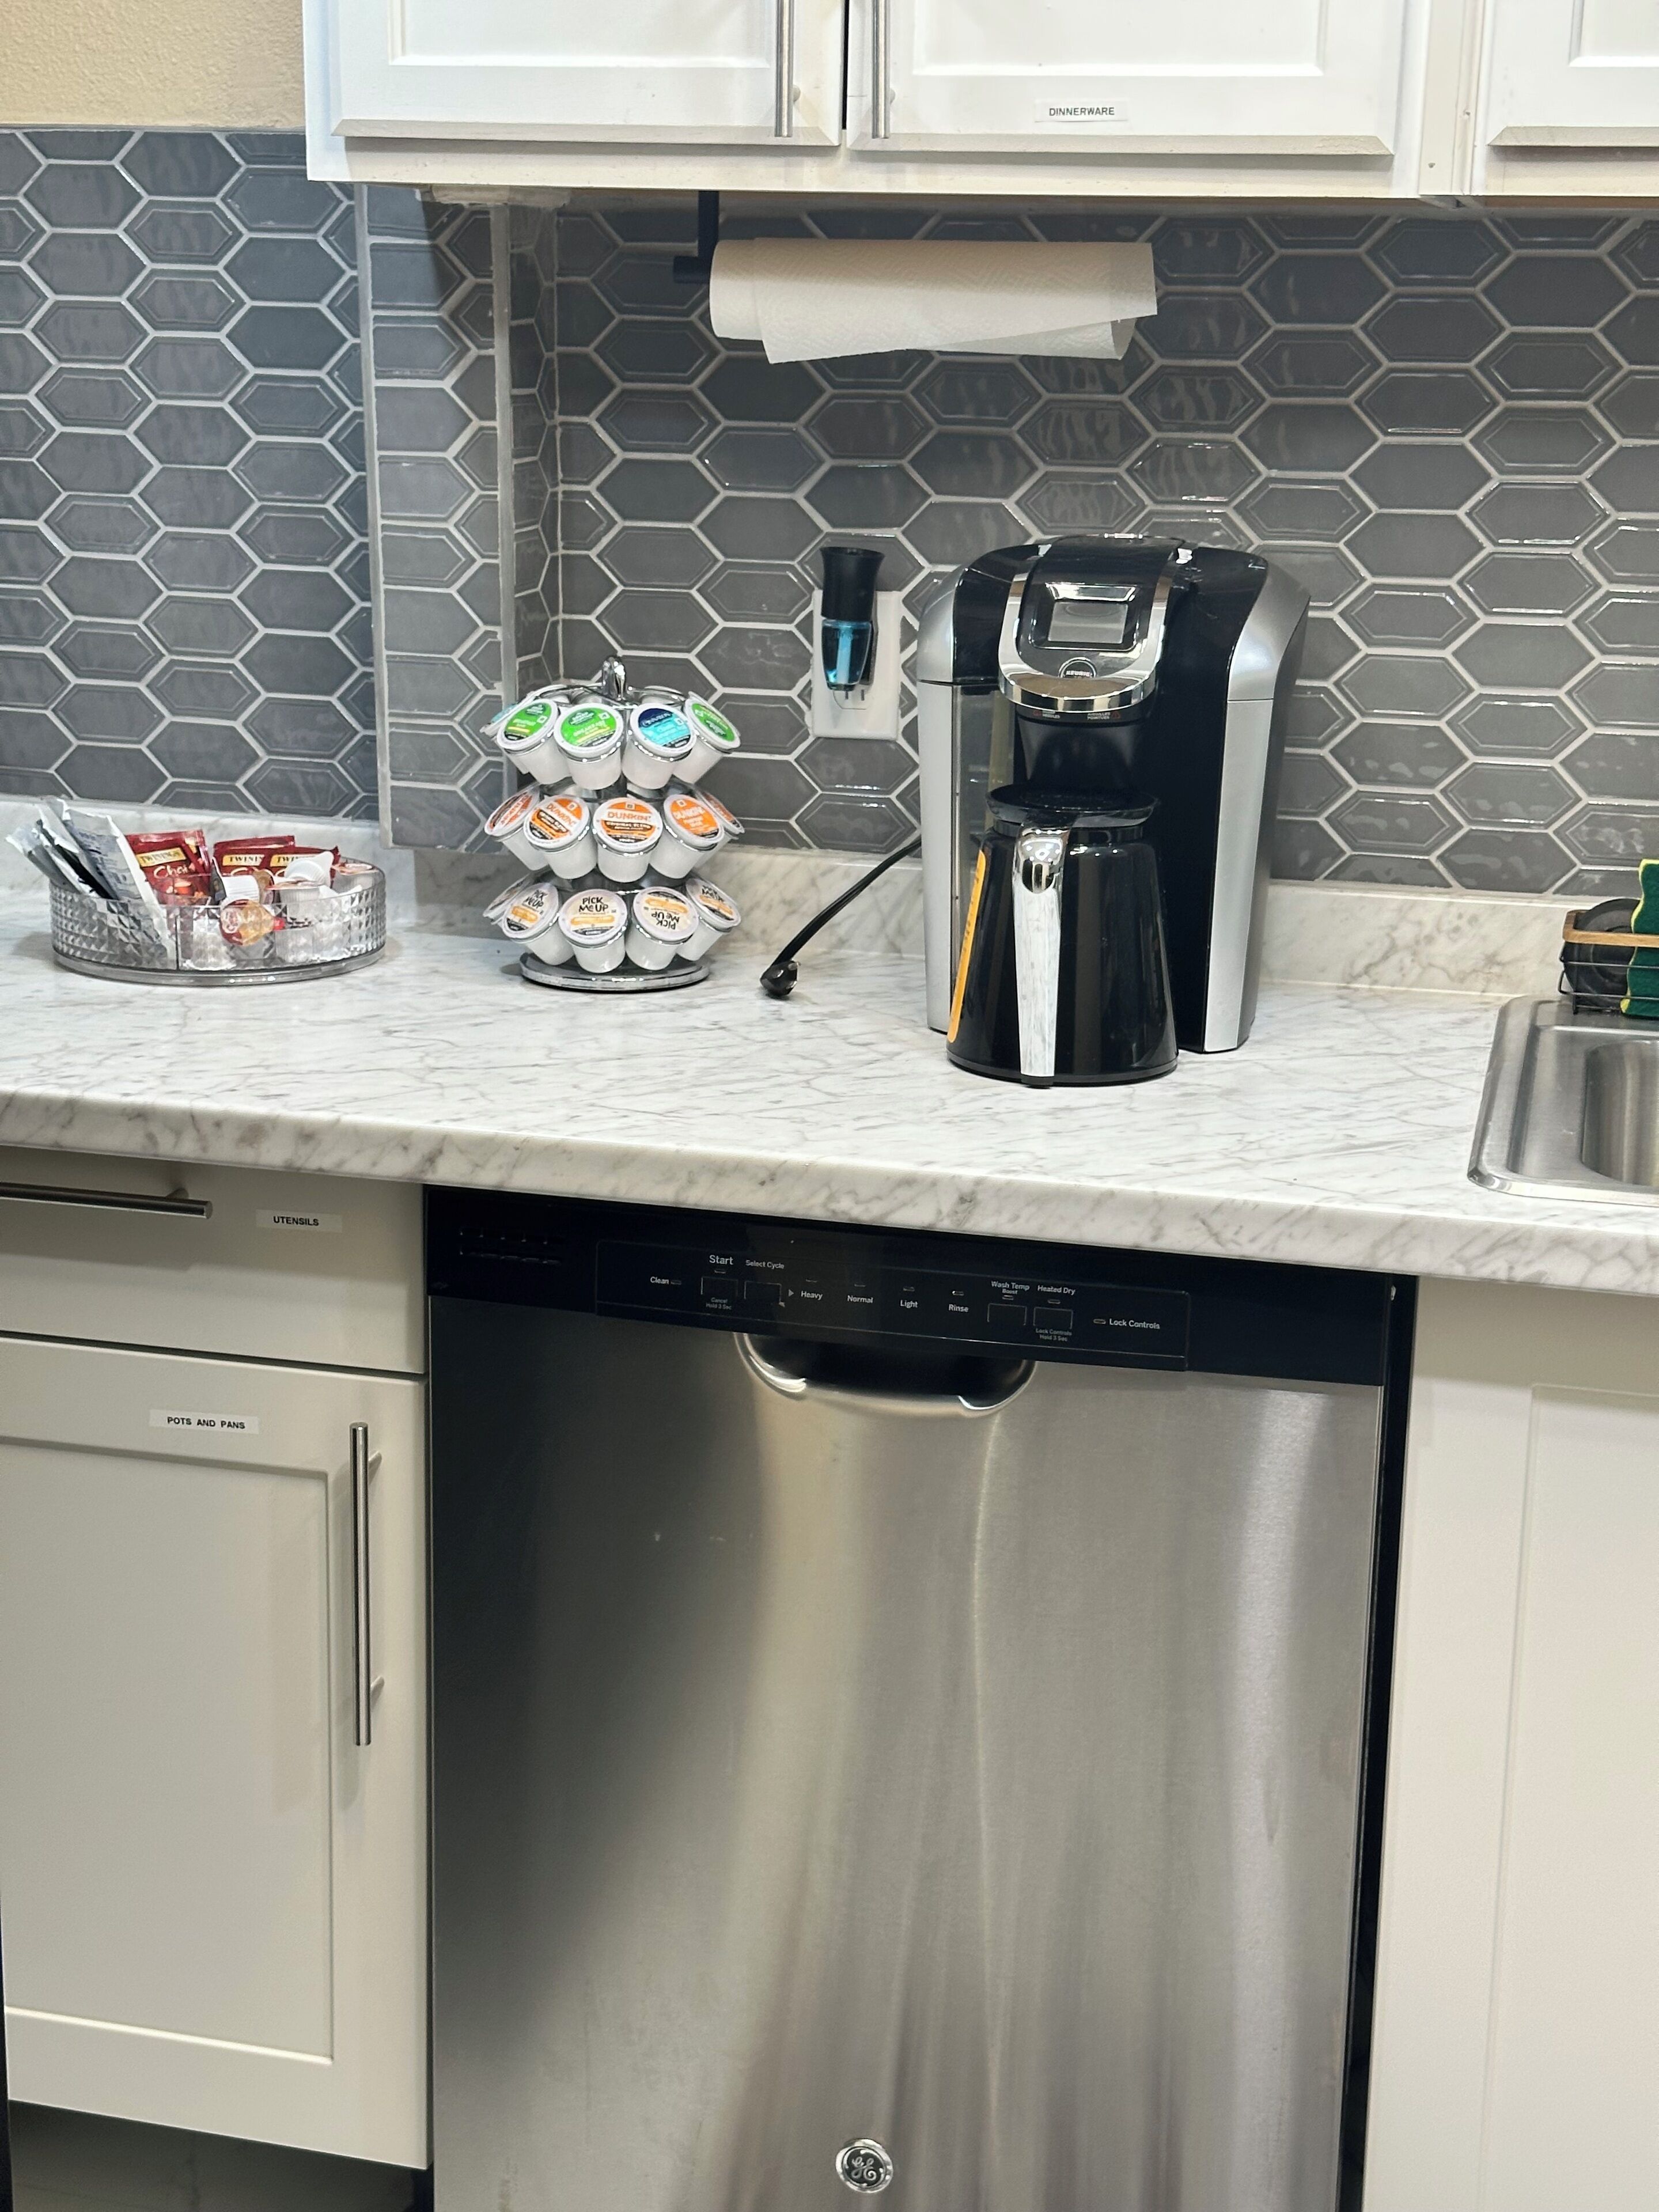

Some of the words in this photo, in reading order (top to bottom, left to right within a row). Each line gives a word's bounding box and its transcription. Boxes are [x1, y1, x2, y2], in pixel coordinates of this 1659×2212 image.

[1049, 107, 1115, 116] DINNERWARE
[154, 865, 188, 879] Chai
[595, 904, 608, 912] UP
[273, 1216, 319, 1226] UTENSILS
[709, 1255, 733, 1265] Start
[767, 1262, 785, 1270] Cycle
[1011, 1282, 1030, 1291] Temp
[1037, 1285, 1062, 1293] Heated
[1063, 1287, 1076, 1296] Dry
[801, 1290, 823, 1300] Heavy
[847, 1295, 873, 1304] Normal
[900, 1300, 918, 1309] Light
[949, 1304, 969, 1312] Rinse
[1109, 1318, 1127, 1326] Lock
[1128, 1320, 1160, 1330] Controls
[167, 1416, 192, 1425] POTS
[196, 1419, 215, 1427] AND
[221, 1421, 245, 1429] PANS
